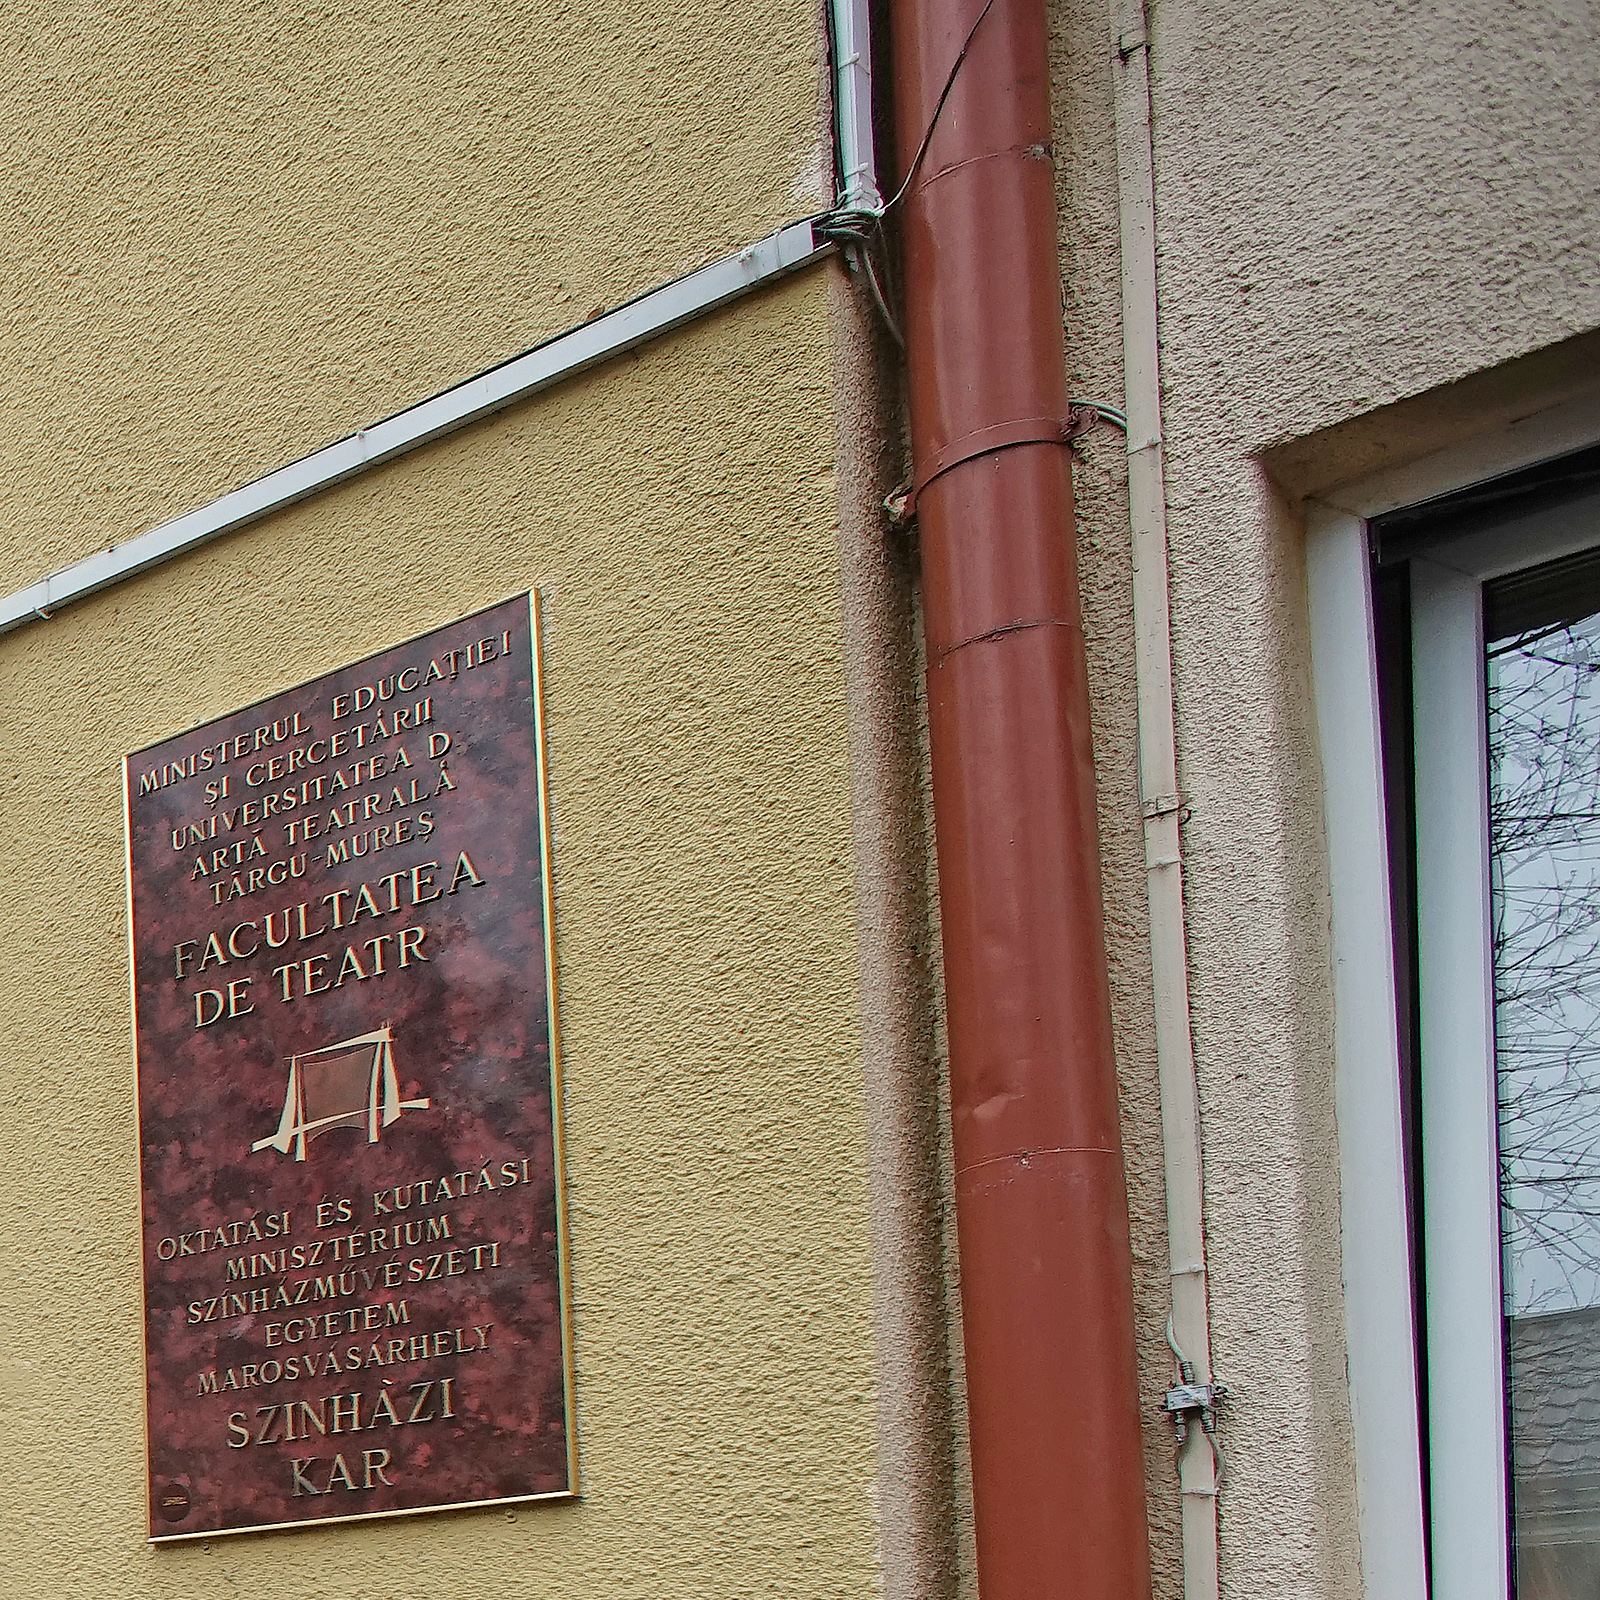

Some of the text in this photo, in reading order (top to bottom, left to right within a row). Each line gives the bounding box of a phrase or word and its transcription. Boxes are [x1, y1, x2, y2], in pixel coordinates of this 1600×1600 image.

[137, 711, 311, 797] MINISTERUL
[171, 747, 414, 851] UNIVERSITATEA
[173, 850, 487, 980] FACULTATEA
[194, 924, 431, 1030] DE TEATR
[156, 1157, 534, 1261] OKTATÁSI ÉS KUTATÁSI
[225, 1213, 454, 1283] MINISZTÉRIUM
[195, 1322, 495, 1397] MAROSVÁSÁRHELY
[264, 1300, 412, 1349] EGYETEM
[289, 1448, 396, 1498] KAR
